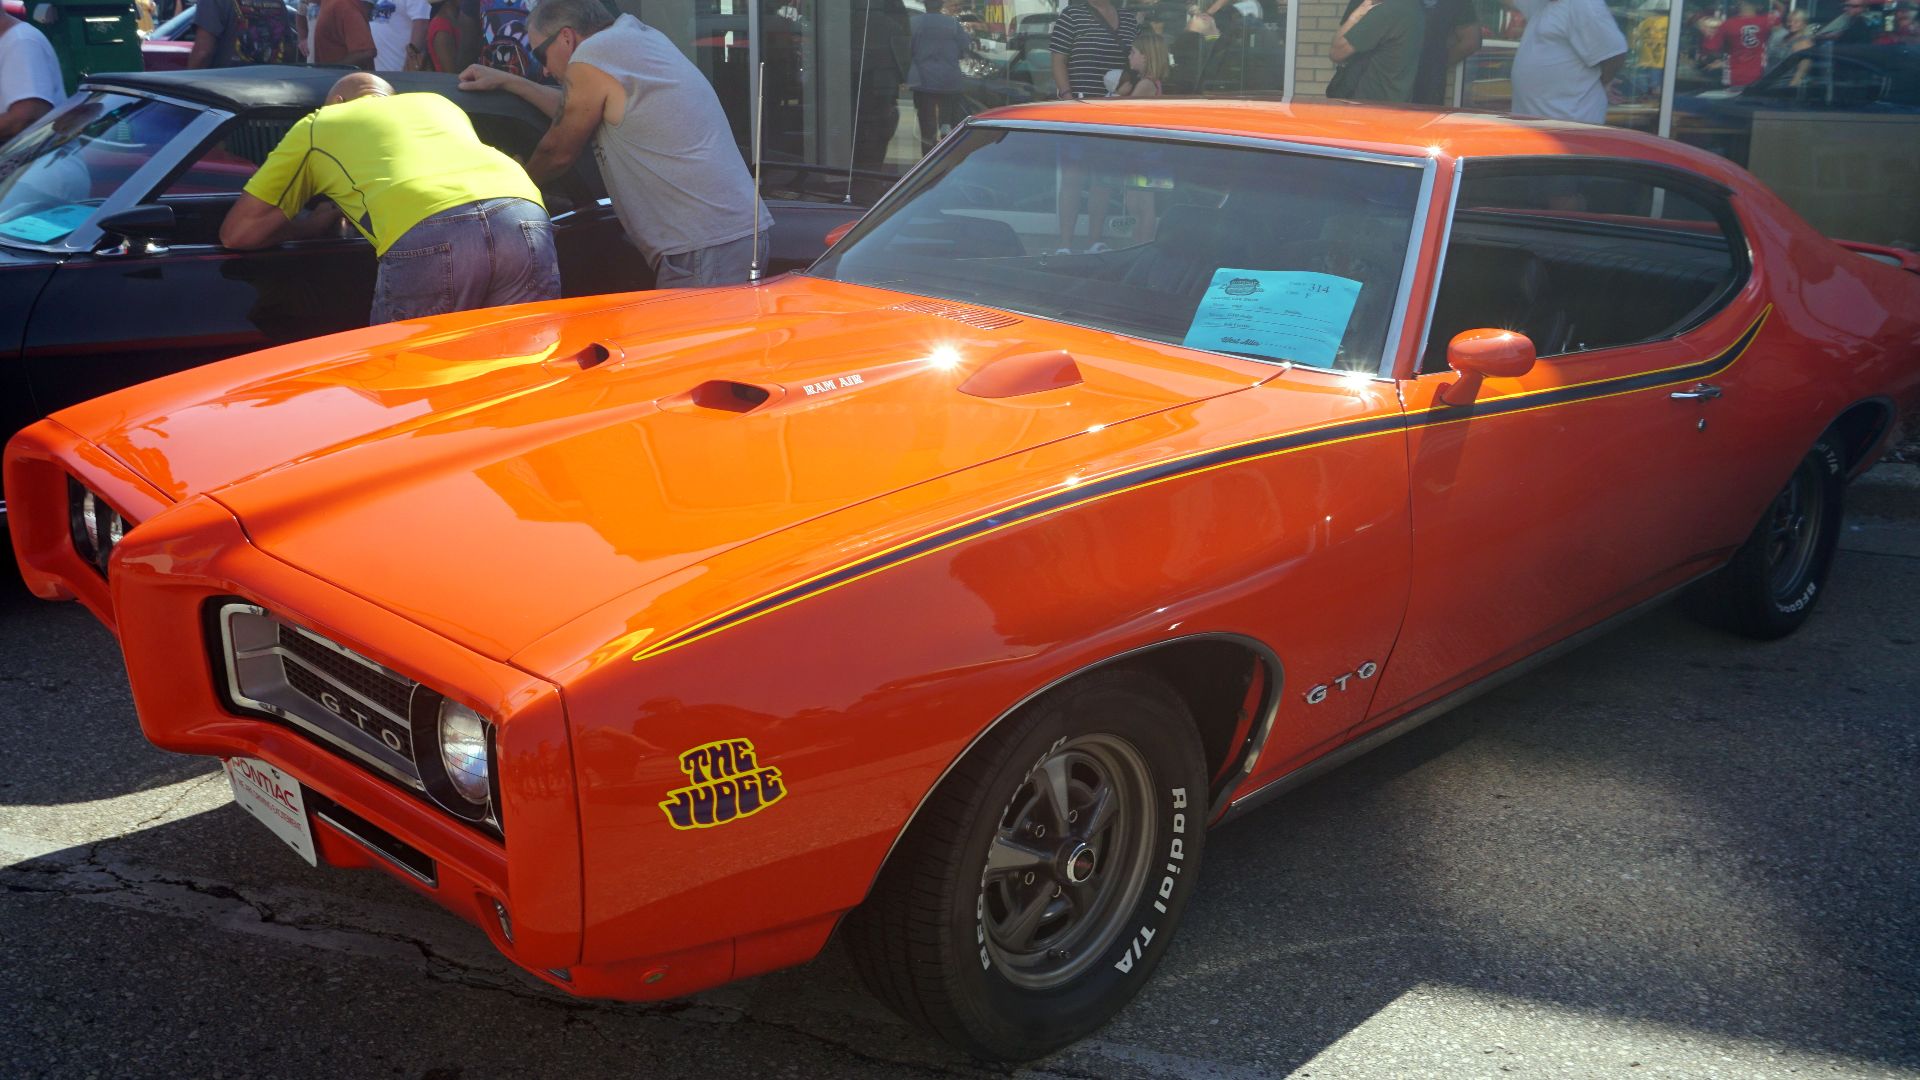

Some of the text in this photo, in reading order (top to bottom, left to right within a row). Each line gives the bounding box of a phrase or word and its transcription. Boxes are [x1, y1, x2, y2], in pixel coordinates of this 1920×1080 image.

[803, 374, 865, 396] RAM AIR
[1306, 661, 1377, 704] GTO
[321, 692, 401, 751] GTO
[680, 738, 757, 785] THE
[660, 767, 787, 830] JUDGE
[1114, 787, 1188, 974] Radial T/A
